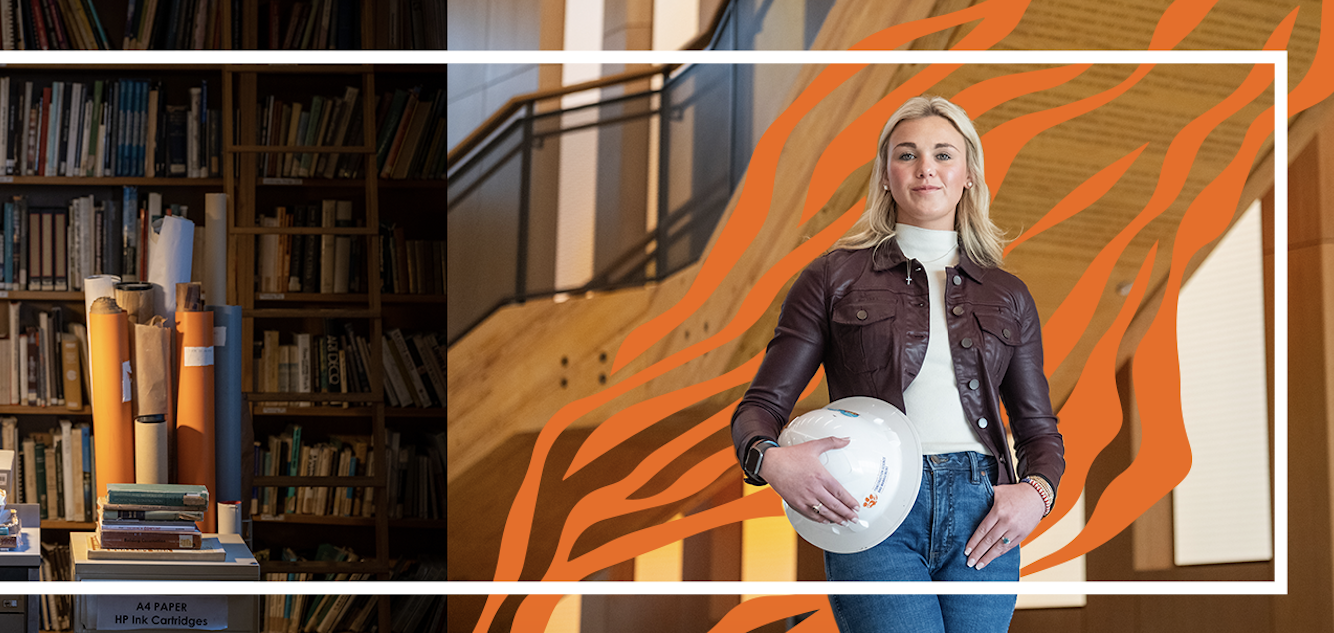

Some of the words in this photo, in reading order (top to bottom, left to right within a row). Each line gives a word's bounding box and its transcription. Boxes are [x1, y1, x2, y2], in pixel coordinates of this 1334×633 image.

[326, 335, 338, 352] ART
[136, 602, 150, 611] A4
[154, 602, 187, 612] PAPER
[115, 615, 128, 624] HP
[132, 615, 148, 624] Ink
[152, 616, 208, 627] Cartridges
